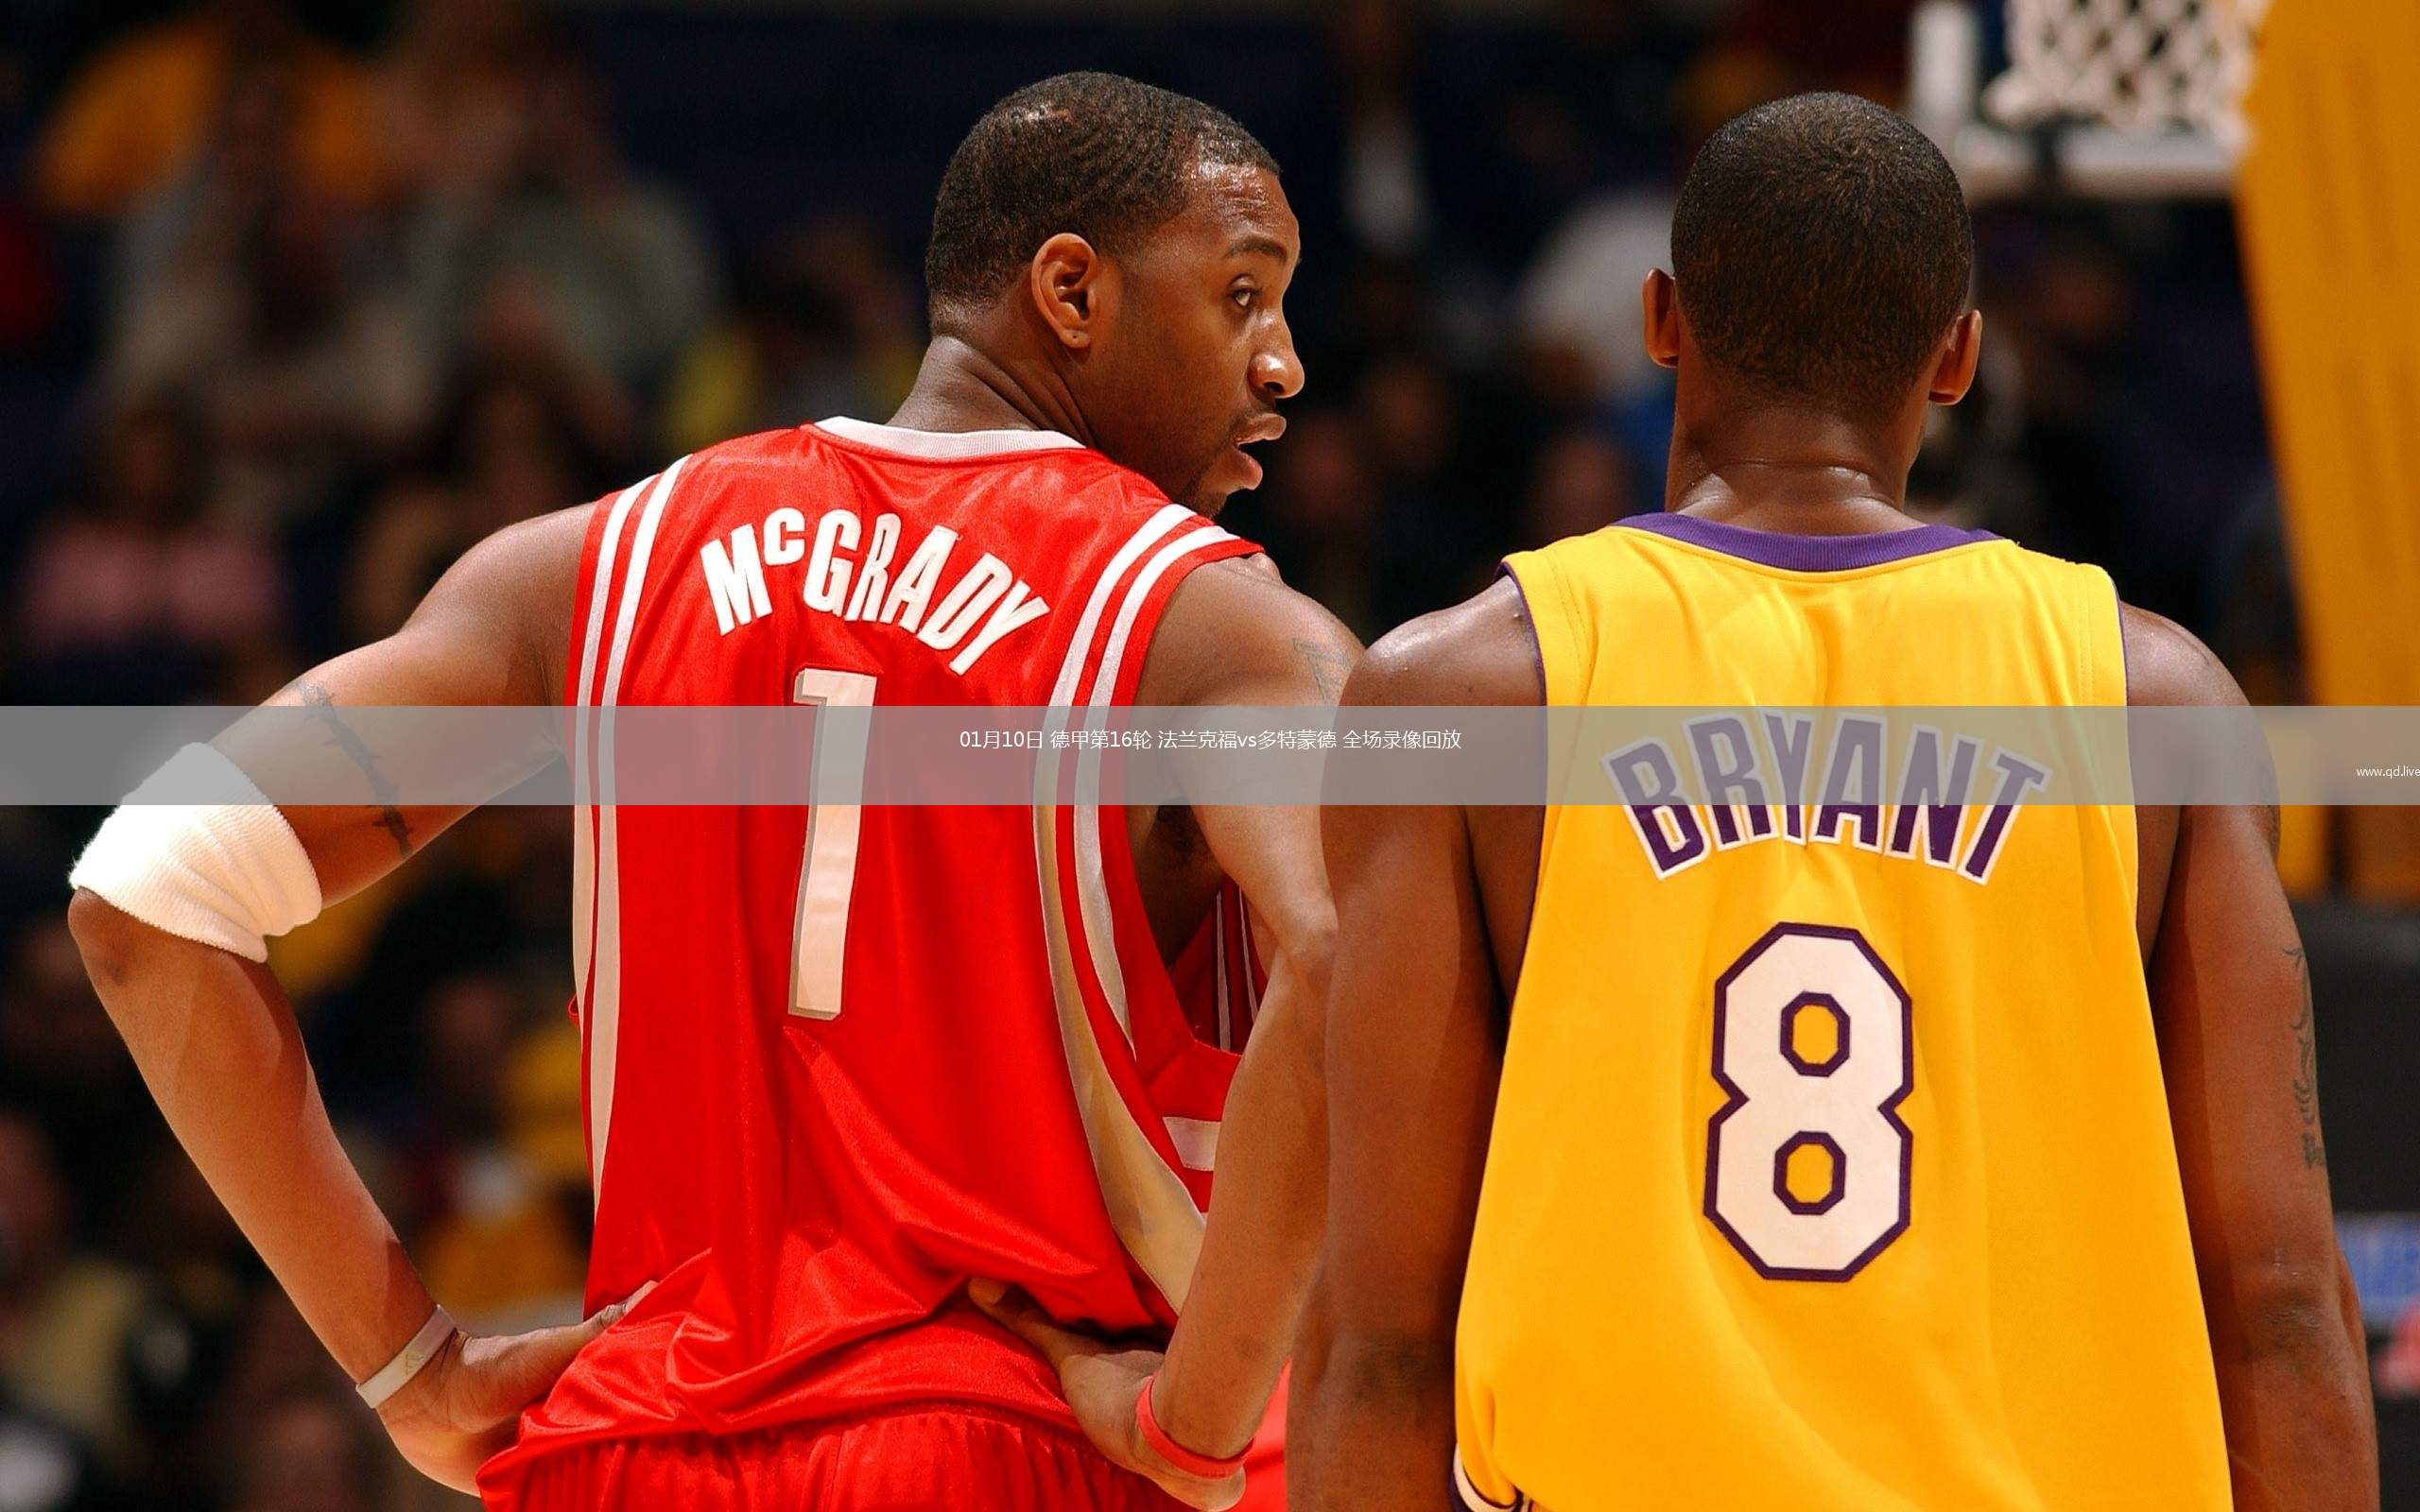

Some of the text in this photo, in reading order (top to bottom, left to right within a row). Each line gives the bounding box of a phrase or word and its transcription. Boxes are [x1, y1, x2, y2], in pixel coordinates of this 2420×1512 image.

[787, 667, 878, 1021] 1
[1601, 708, 2053, 885] BRYANT
[1703, 921, 1913, 1282] 8
